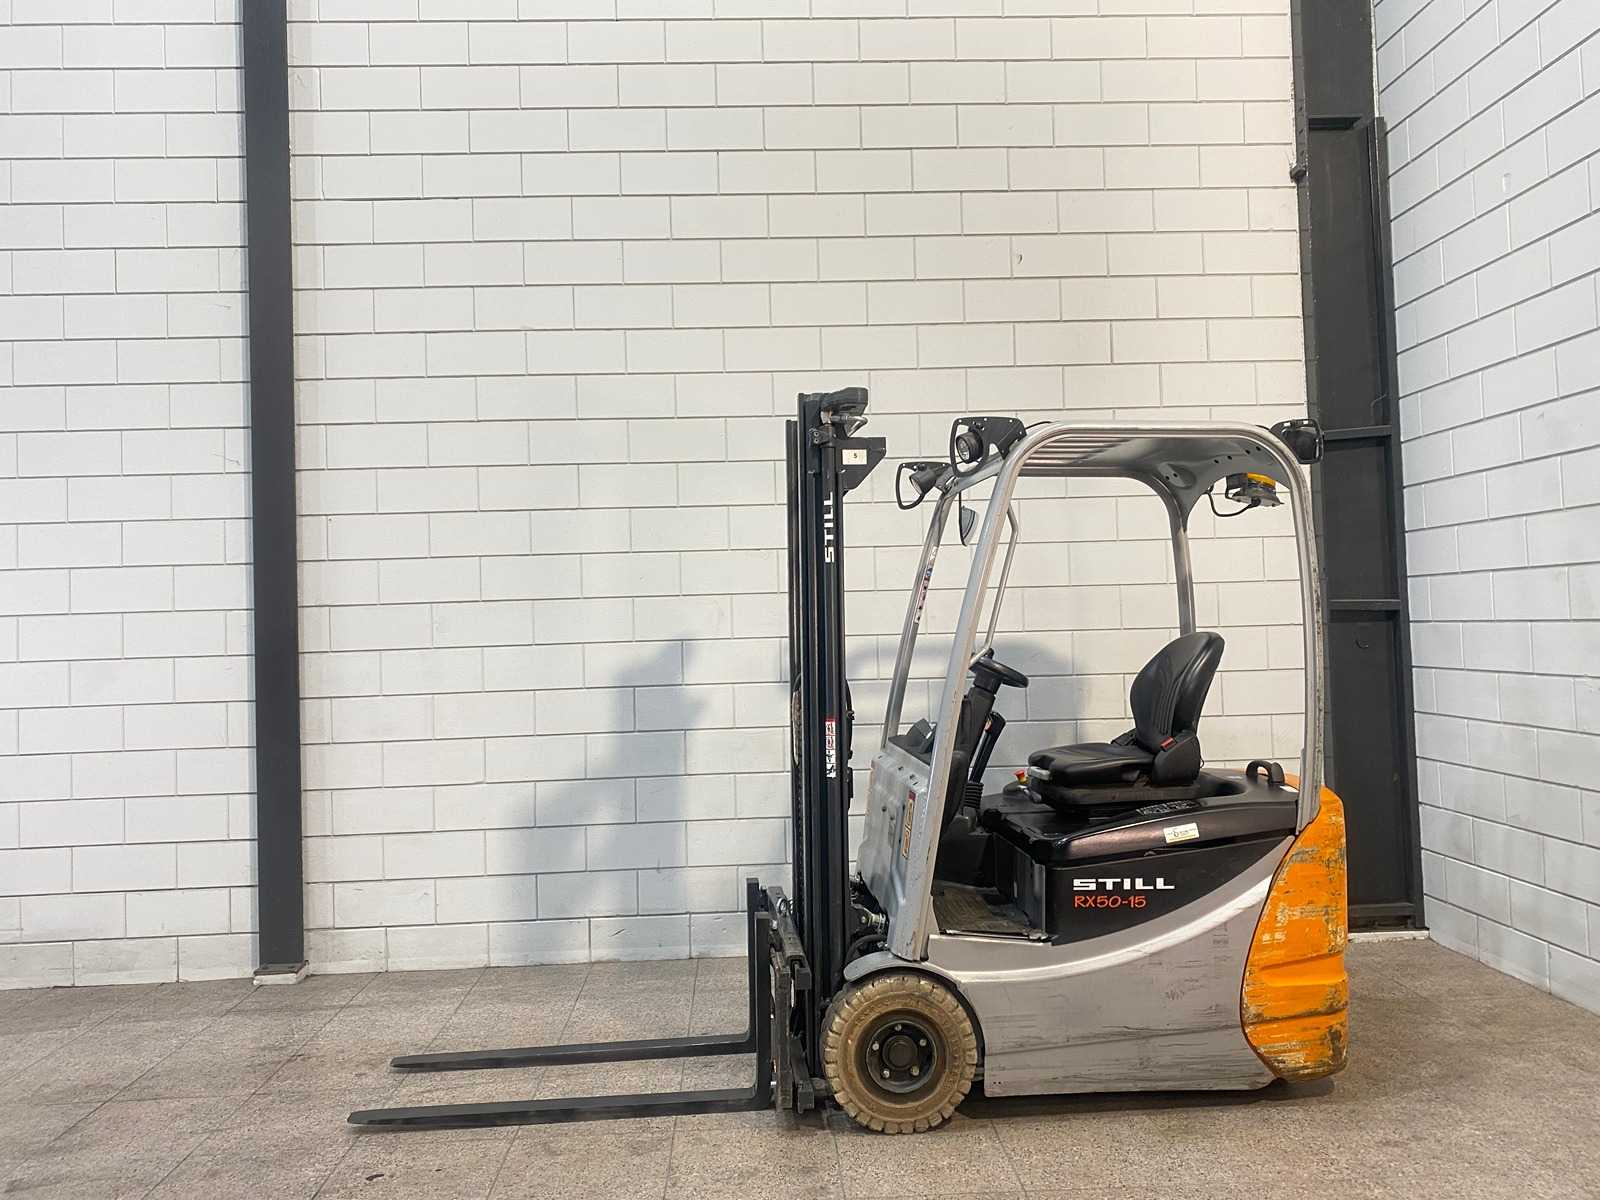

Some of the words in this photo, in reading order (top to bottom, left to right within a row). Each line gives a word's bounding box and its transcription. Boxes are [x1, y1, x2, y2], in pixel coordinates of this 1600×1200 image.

[824, 492, 835, 564] STILL
[1073, 878, 1175, 891] STILL
[1074, 895, 1147, 908] RX50-15
